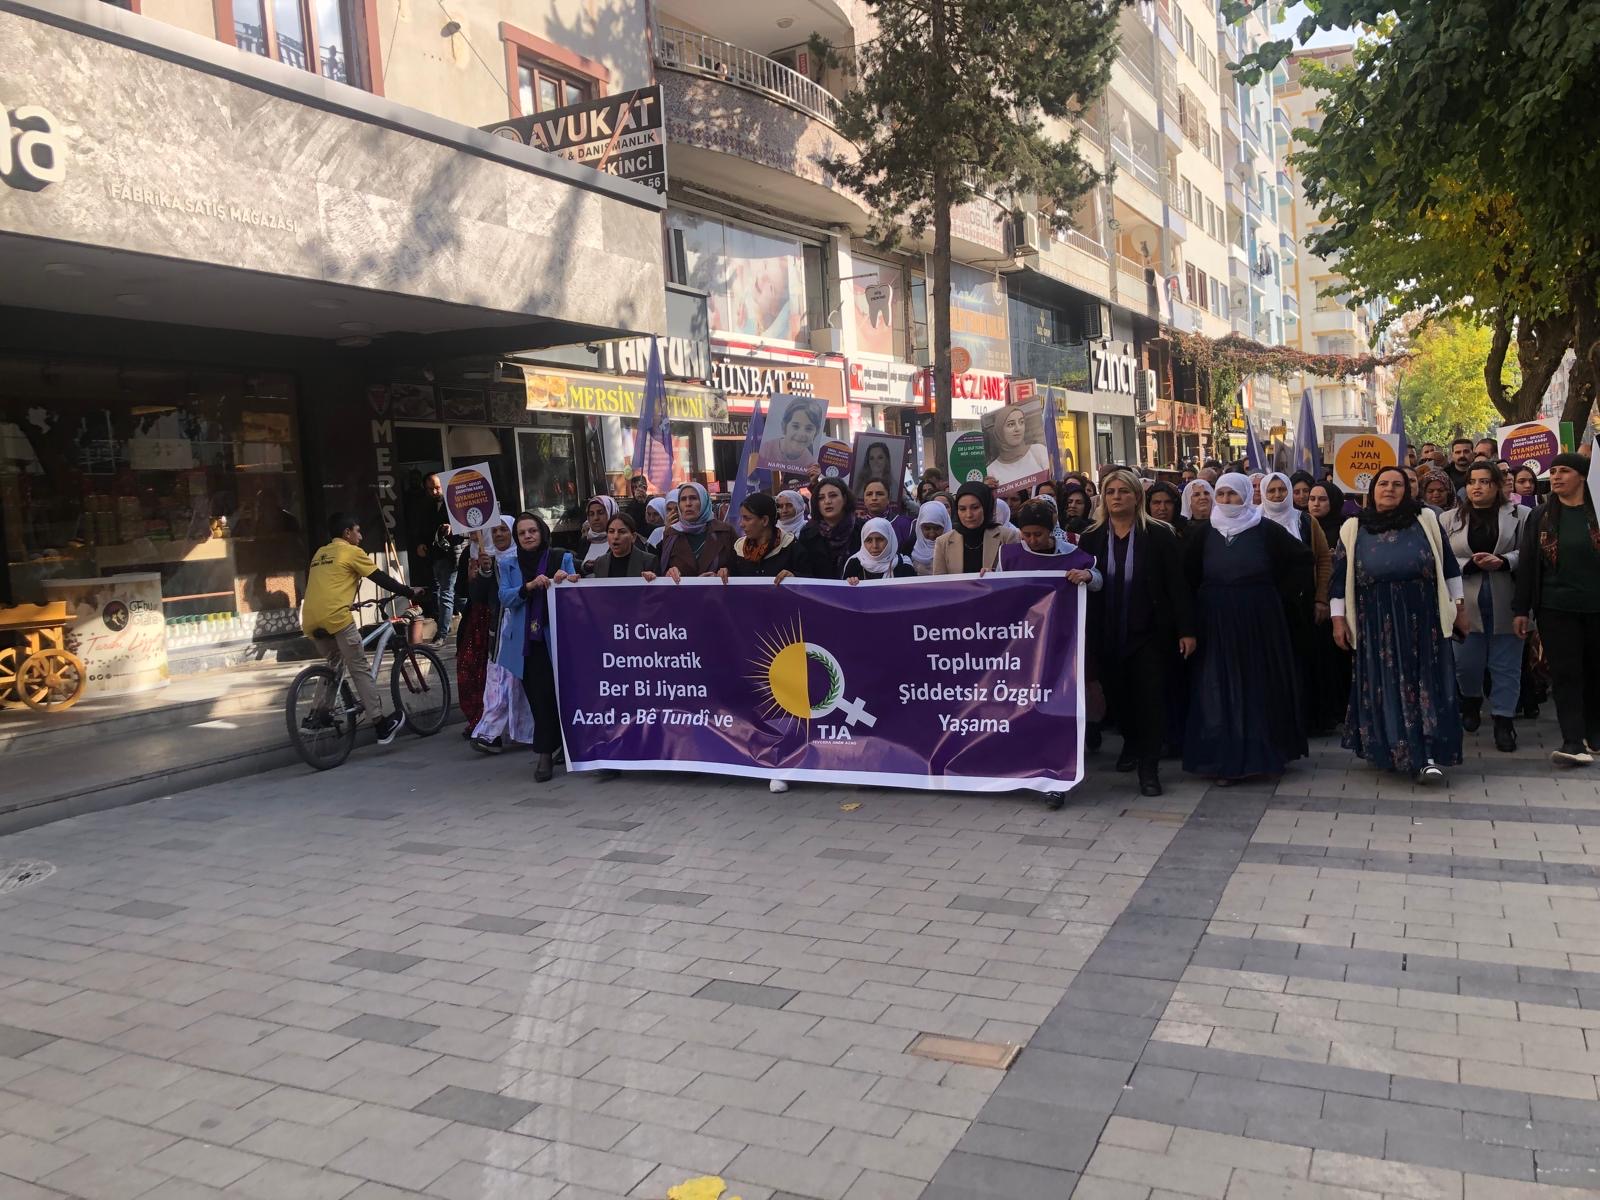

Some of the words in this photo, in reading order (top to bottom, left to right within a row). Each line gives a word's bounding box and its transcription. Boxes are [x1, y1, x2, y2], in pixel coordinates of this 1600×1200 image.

[529, 97, 654, 149] AVUKAT
[110, 184, 182, 210] FABRİKA
[184, 200, 226, 220] SATIŞ
[229, 207, 298, 233] MAĞAZASI
[951, 372, 1004, 401] ECZANE
[569, 385, 636, 413] MERSİN
[1358, 440, 1374, 448] JIN
[1351, 452, 1380, 460] JIYAN
[613, 624, 629, 640] Bi
[634, 623, 688, 640] Civaka
[913, 621, 1035, 642] Demokratik
[602, 652, 702, 669] Demokratik
[927, 652, 1021, 674] Toplumla
[599, 680, 629, 697] Ber
[634, 680, 650, 697] Bi
[655, 681, 707, 701] Jiyana
[899, 681, 988, 705] Şiddetsiz
[993, 680, 1052, 706] Özgür
[572, 708, 615, 725] Azad
[620, 713, 631, 725] a
[636, 709, 656, 725] Bê
[662, 709, 709, 727] Tundî
[713, 714, 734, 729] ve
[938, 713, 1010, 736] Yaşama
[816, 724, 852, 740] TJA
